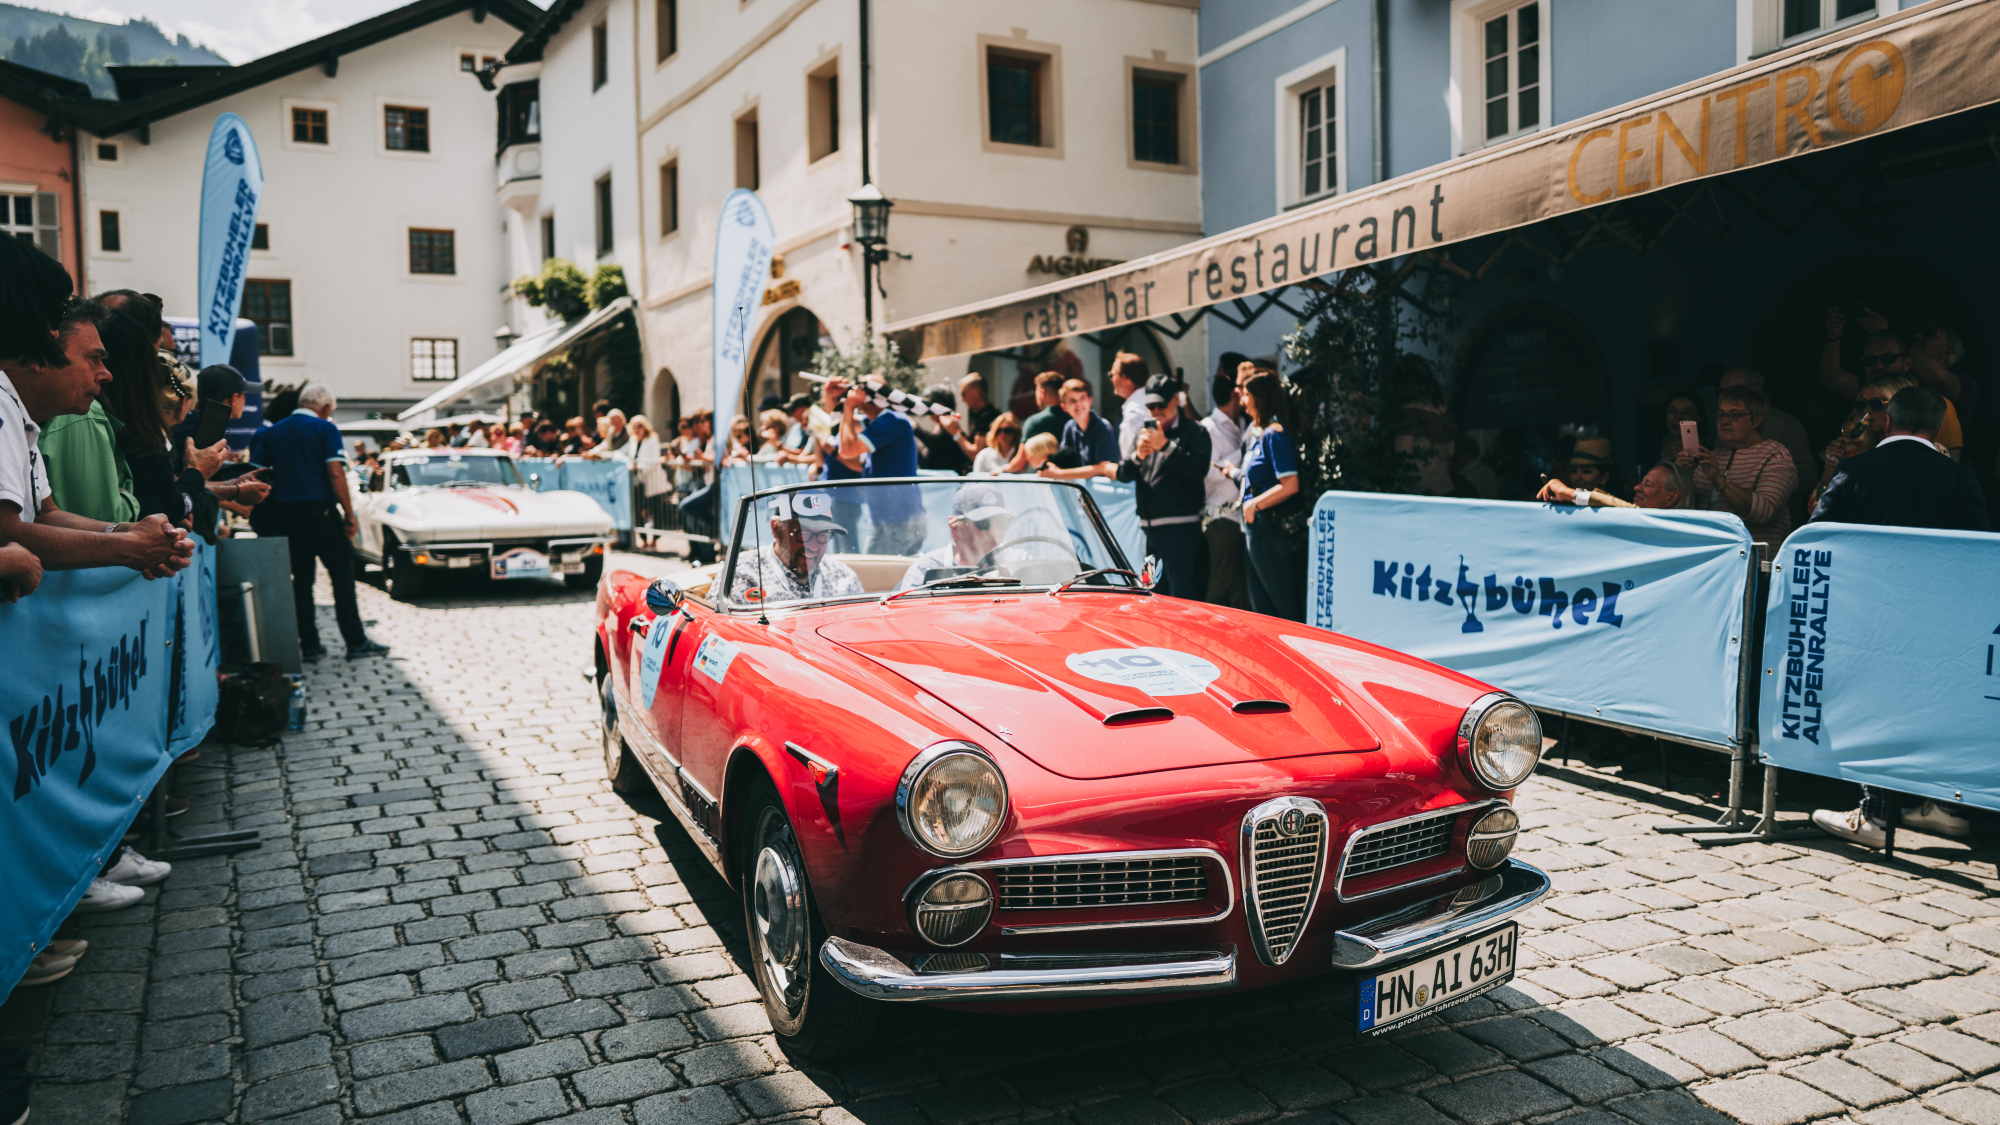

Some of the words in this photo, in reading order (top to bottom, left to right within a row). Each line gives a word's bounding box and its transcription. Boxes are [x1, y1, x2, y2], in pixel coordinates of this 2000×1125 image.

[1567, 40, 1905, 205] CENTRO
[218, 190, 257, 346] ALPENRALLYE
[1103, 278, 1155, 325] bar
[1188, 184, 1444, 306] restaurant
[768, 489, 832, 521] 10
[1316, 509, 1327, 628] ITZBÜHELER
[1325, 509, 1336, 629] LPENRALLYE
[652, 619, 669, 649] 10
[1782, 548, 1812, 740] KITZBÜHELER
[1802, 550, 1832, 745] ALPENRALLYE
[1363, 1009, 1370, 1020] D
[1372, 978, 1506, 1037] www.prodrive-fahrzeugtechnik.de
[1376, 970, 1414, 1019] HN
[1432, 953, 1462, 999] AI
[1470, 931, 1513, 983] 63H
